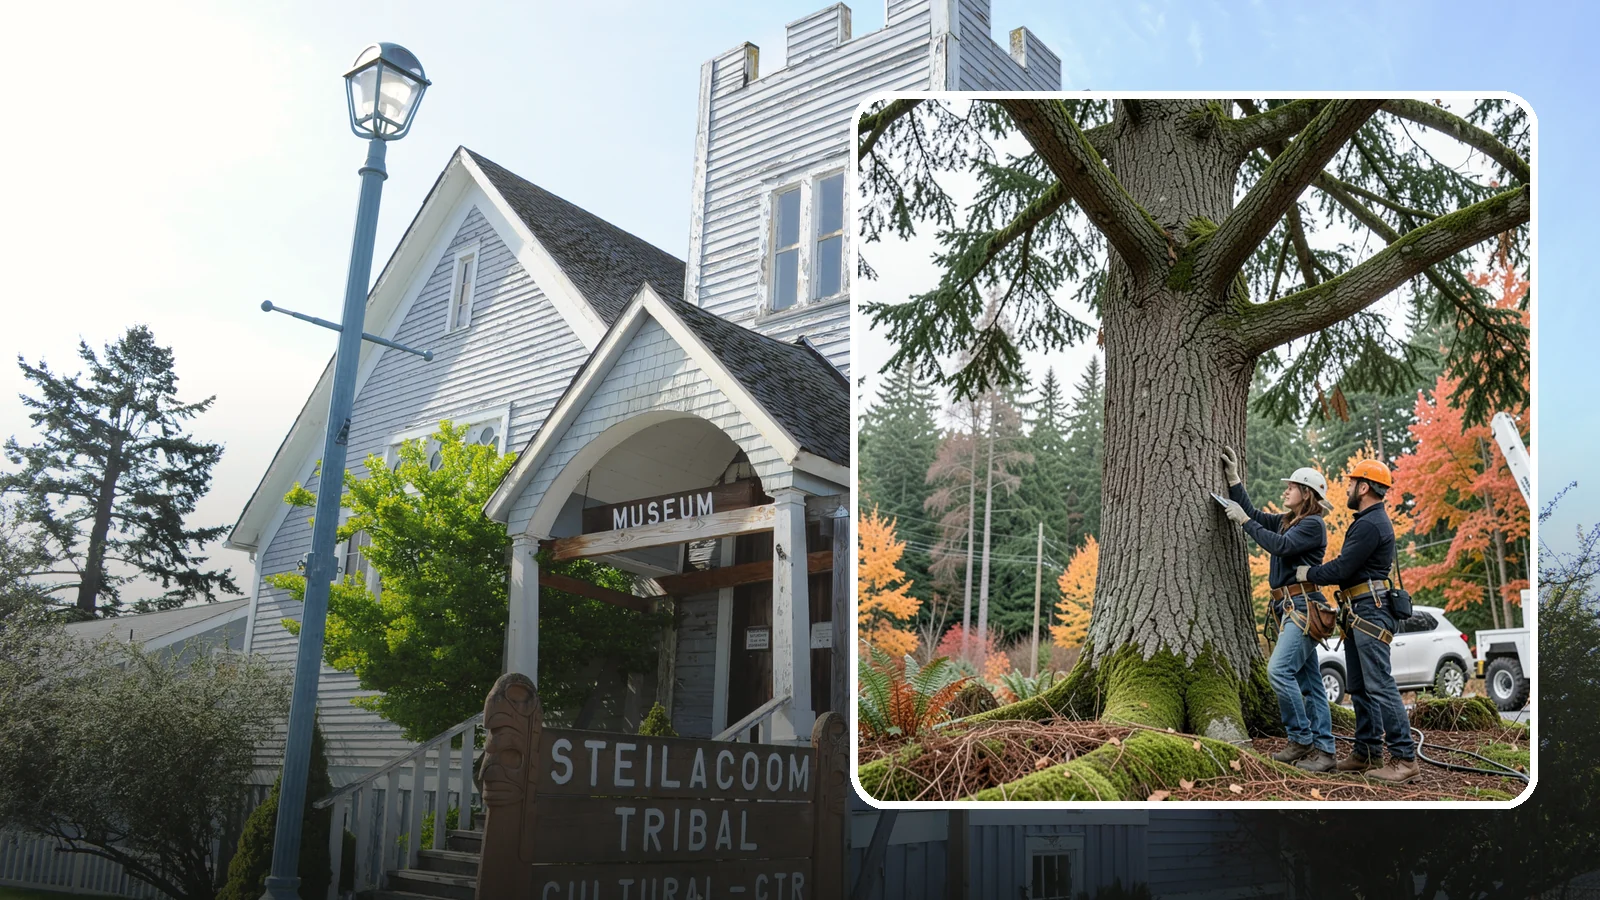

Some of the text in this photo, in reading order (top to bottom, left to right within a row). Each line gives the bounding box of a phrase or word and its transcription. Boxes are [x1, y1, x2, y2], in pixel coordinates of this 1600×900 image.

[613, 492, 713, 530] MUSEUM
[551, 738, 809, 792] STEILACOOM
[614, 806, 758, 852] TRIBAL
